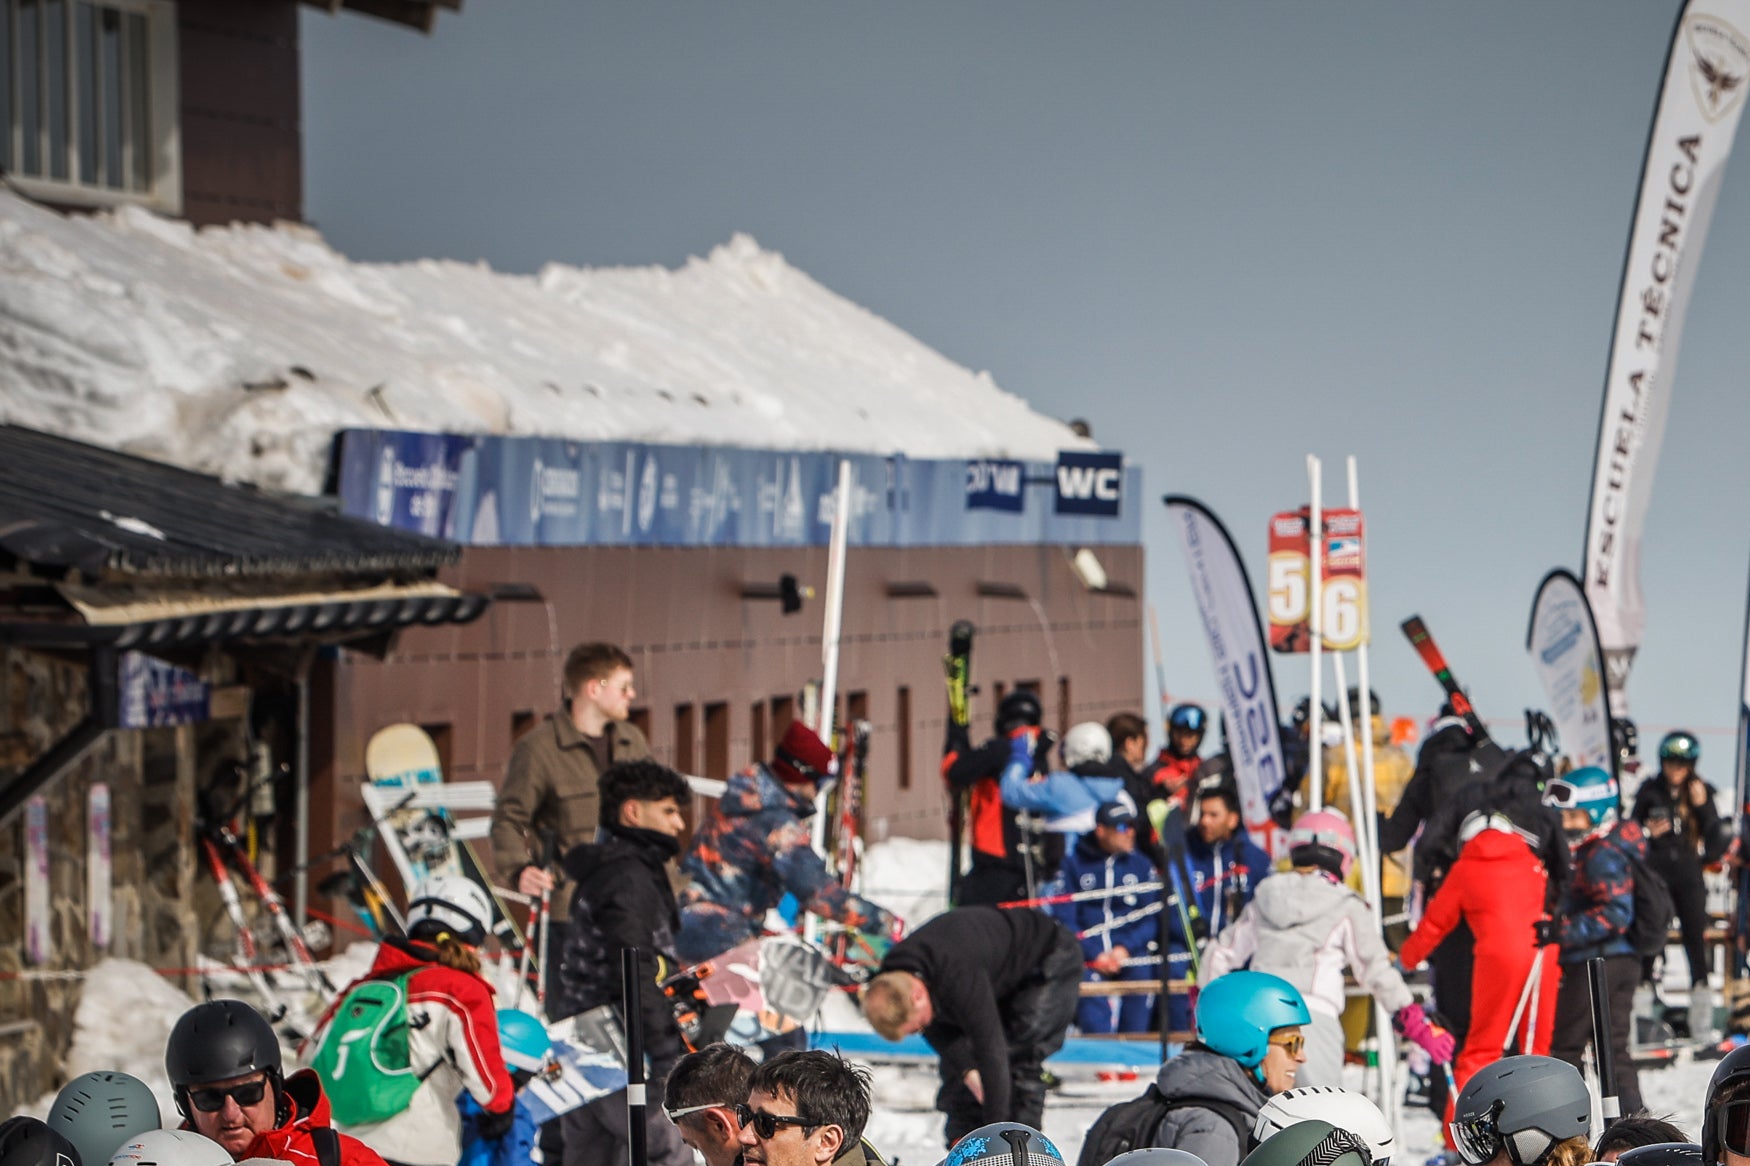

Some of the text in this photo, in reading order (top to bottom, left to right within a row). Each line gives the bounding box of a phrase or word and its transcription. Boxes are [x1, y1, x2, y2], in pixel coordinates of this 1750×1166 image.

[1594, 365, 1646, 590] ESCUELA
[1634, 134, 1703, 353] TÉCNICA
[1058, 466, 1121, 500] WC
[1269, 556, 1308, 621] 5
[1322, 579, 1360, 644] 6
